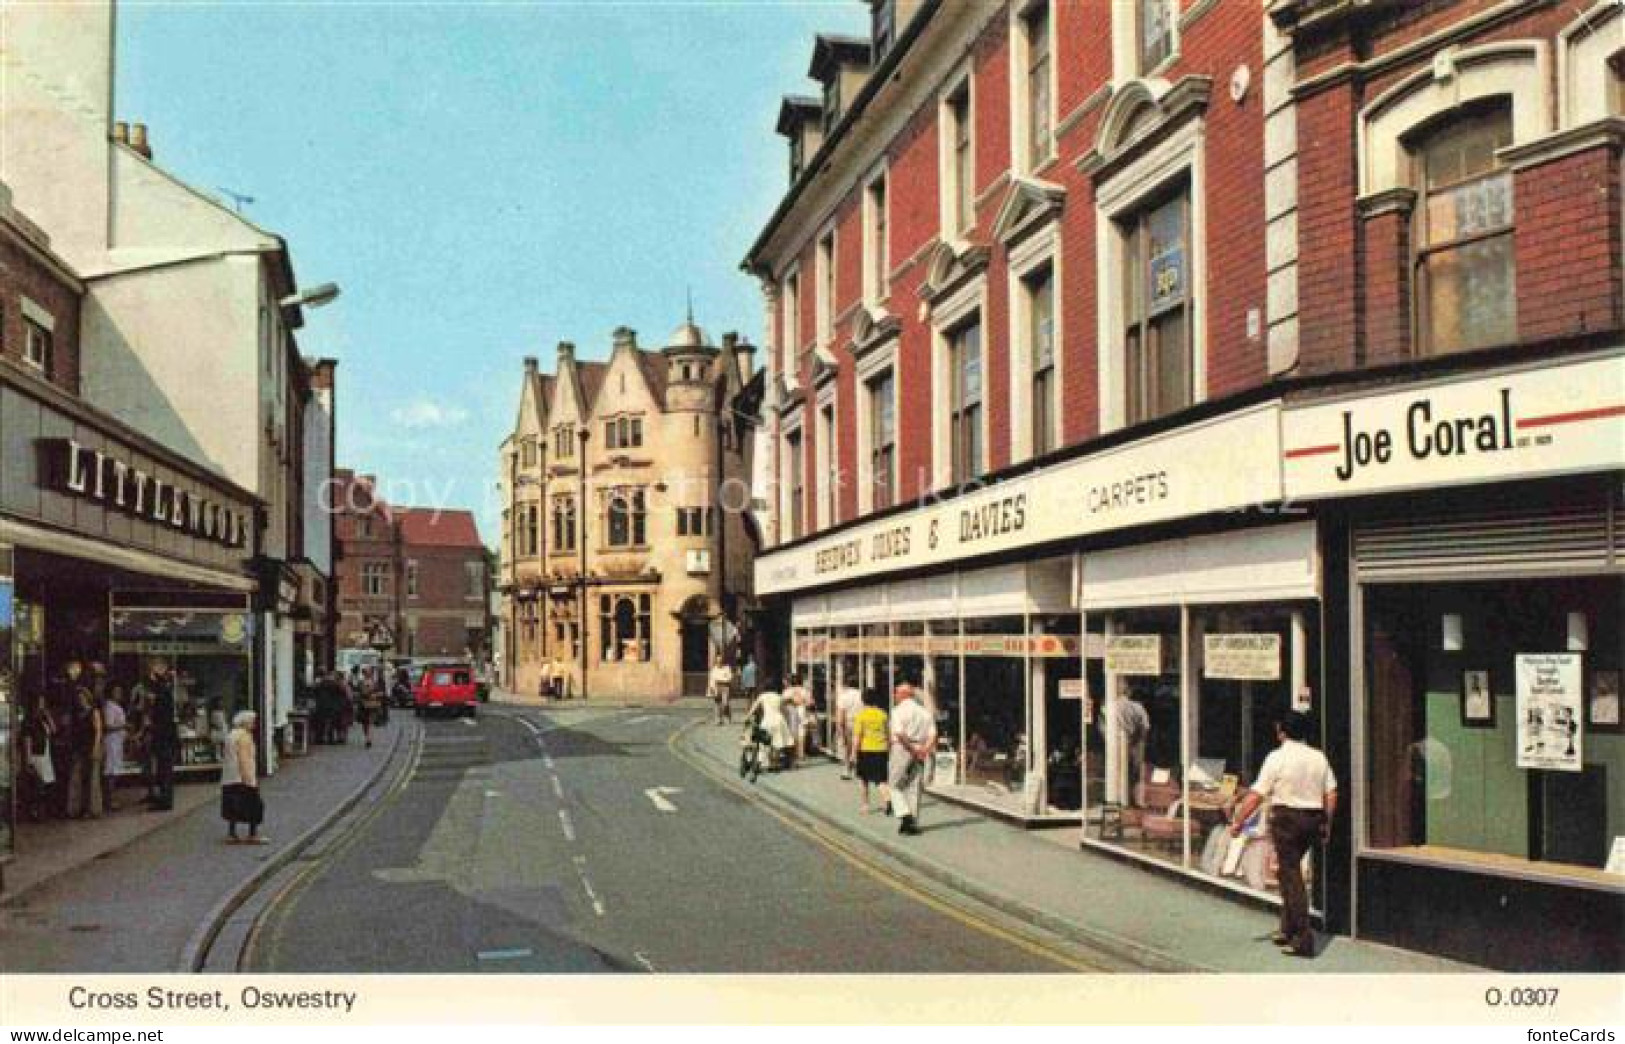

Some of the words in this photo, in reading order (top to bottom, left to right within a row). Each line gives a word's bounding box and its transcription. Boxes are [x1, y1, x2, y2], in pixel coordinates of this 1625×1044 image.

[1335, 411, 1392, 481] Joe
[1407, 388, 1514, 459] Coral
[1089, 470, 1169, 513] CARPETS
[870, 526, 911, 561] JONES
[958, 492, 1026, 544] DAVIES
